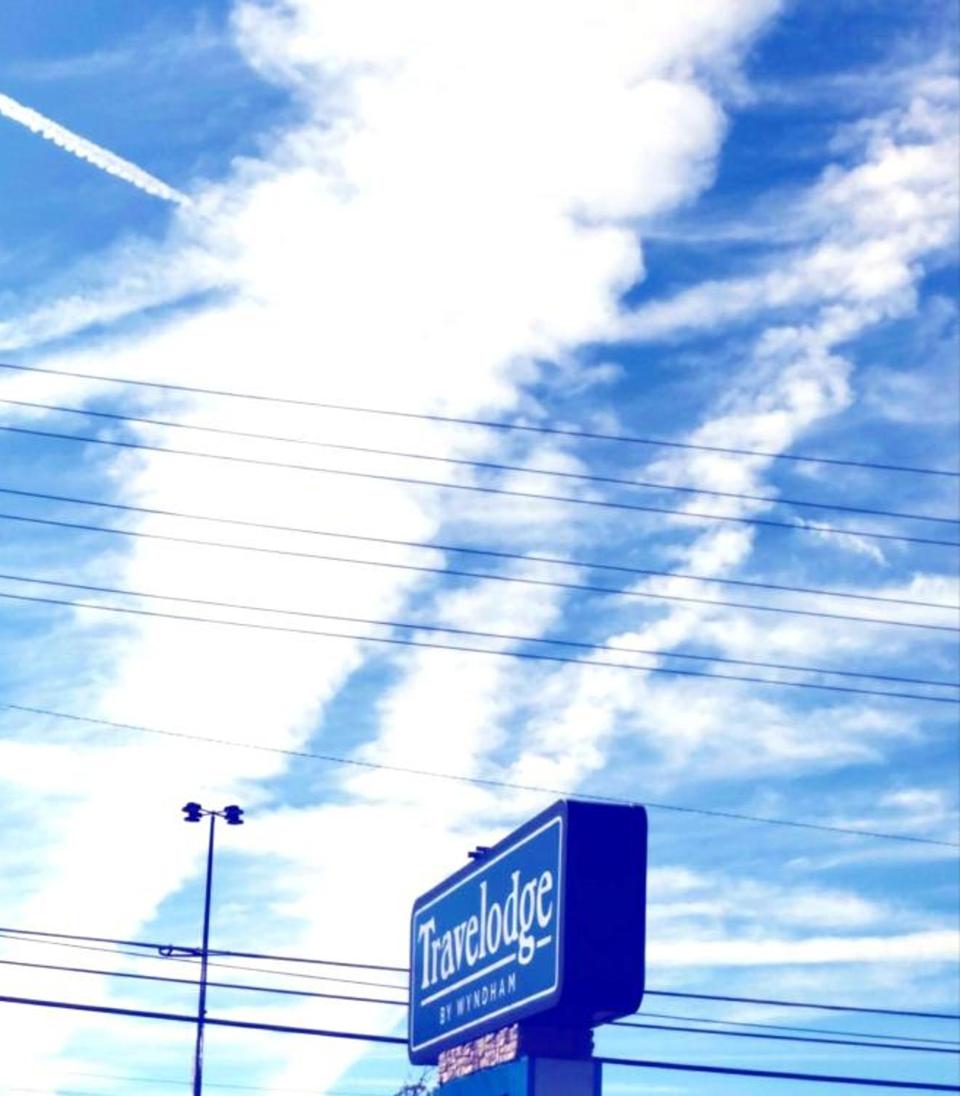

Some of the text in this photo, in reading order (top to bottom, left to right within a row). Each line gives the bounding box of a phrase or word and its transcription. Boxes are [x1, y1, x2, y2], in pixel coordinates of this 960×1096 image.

[417, 870, 553, 990] Travelodge
[439, 972, 516, 1025] BY WYNDHAM
